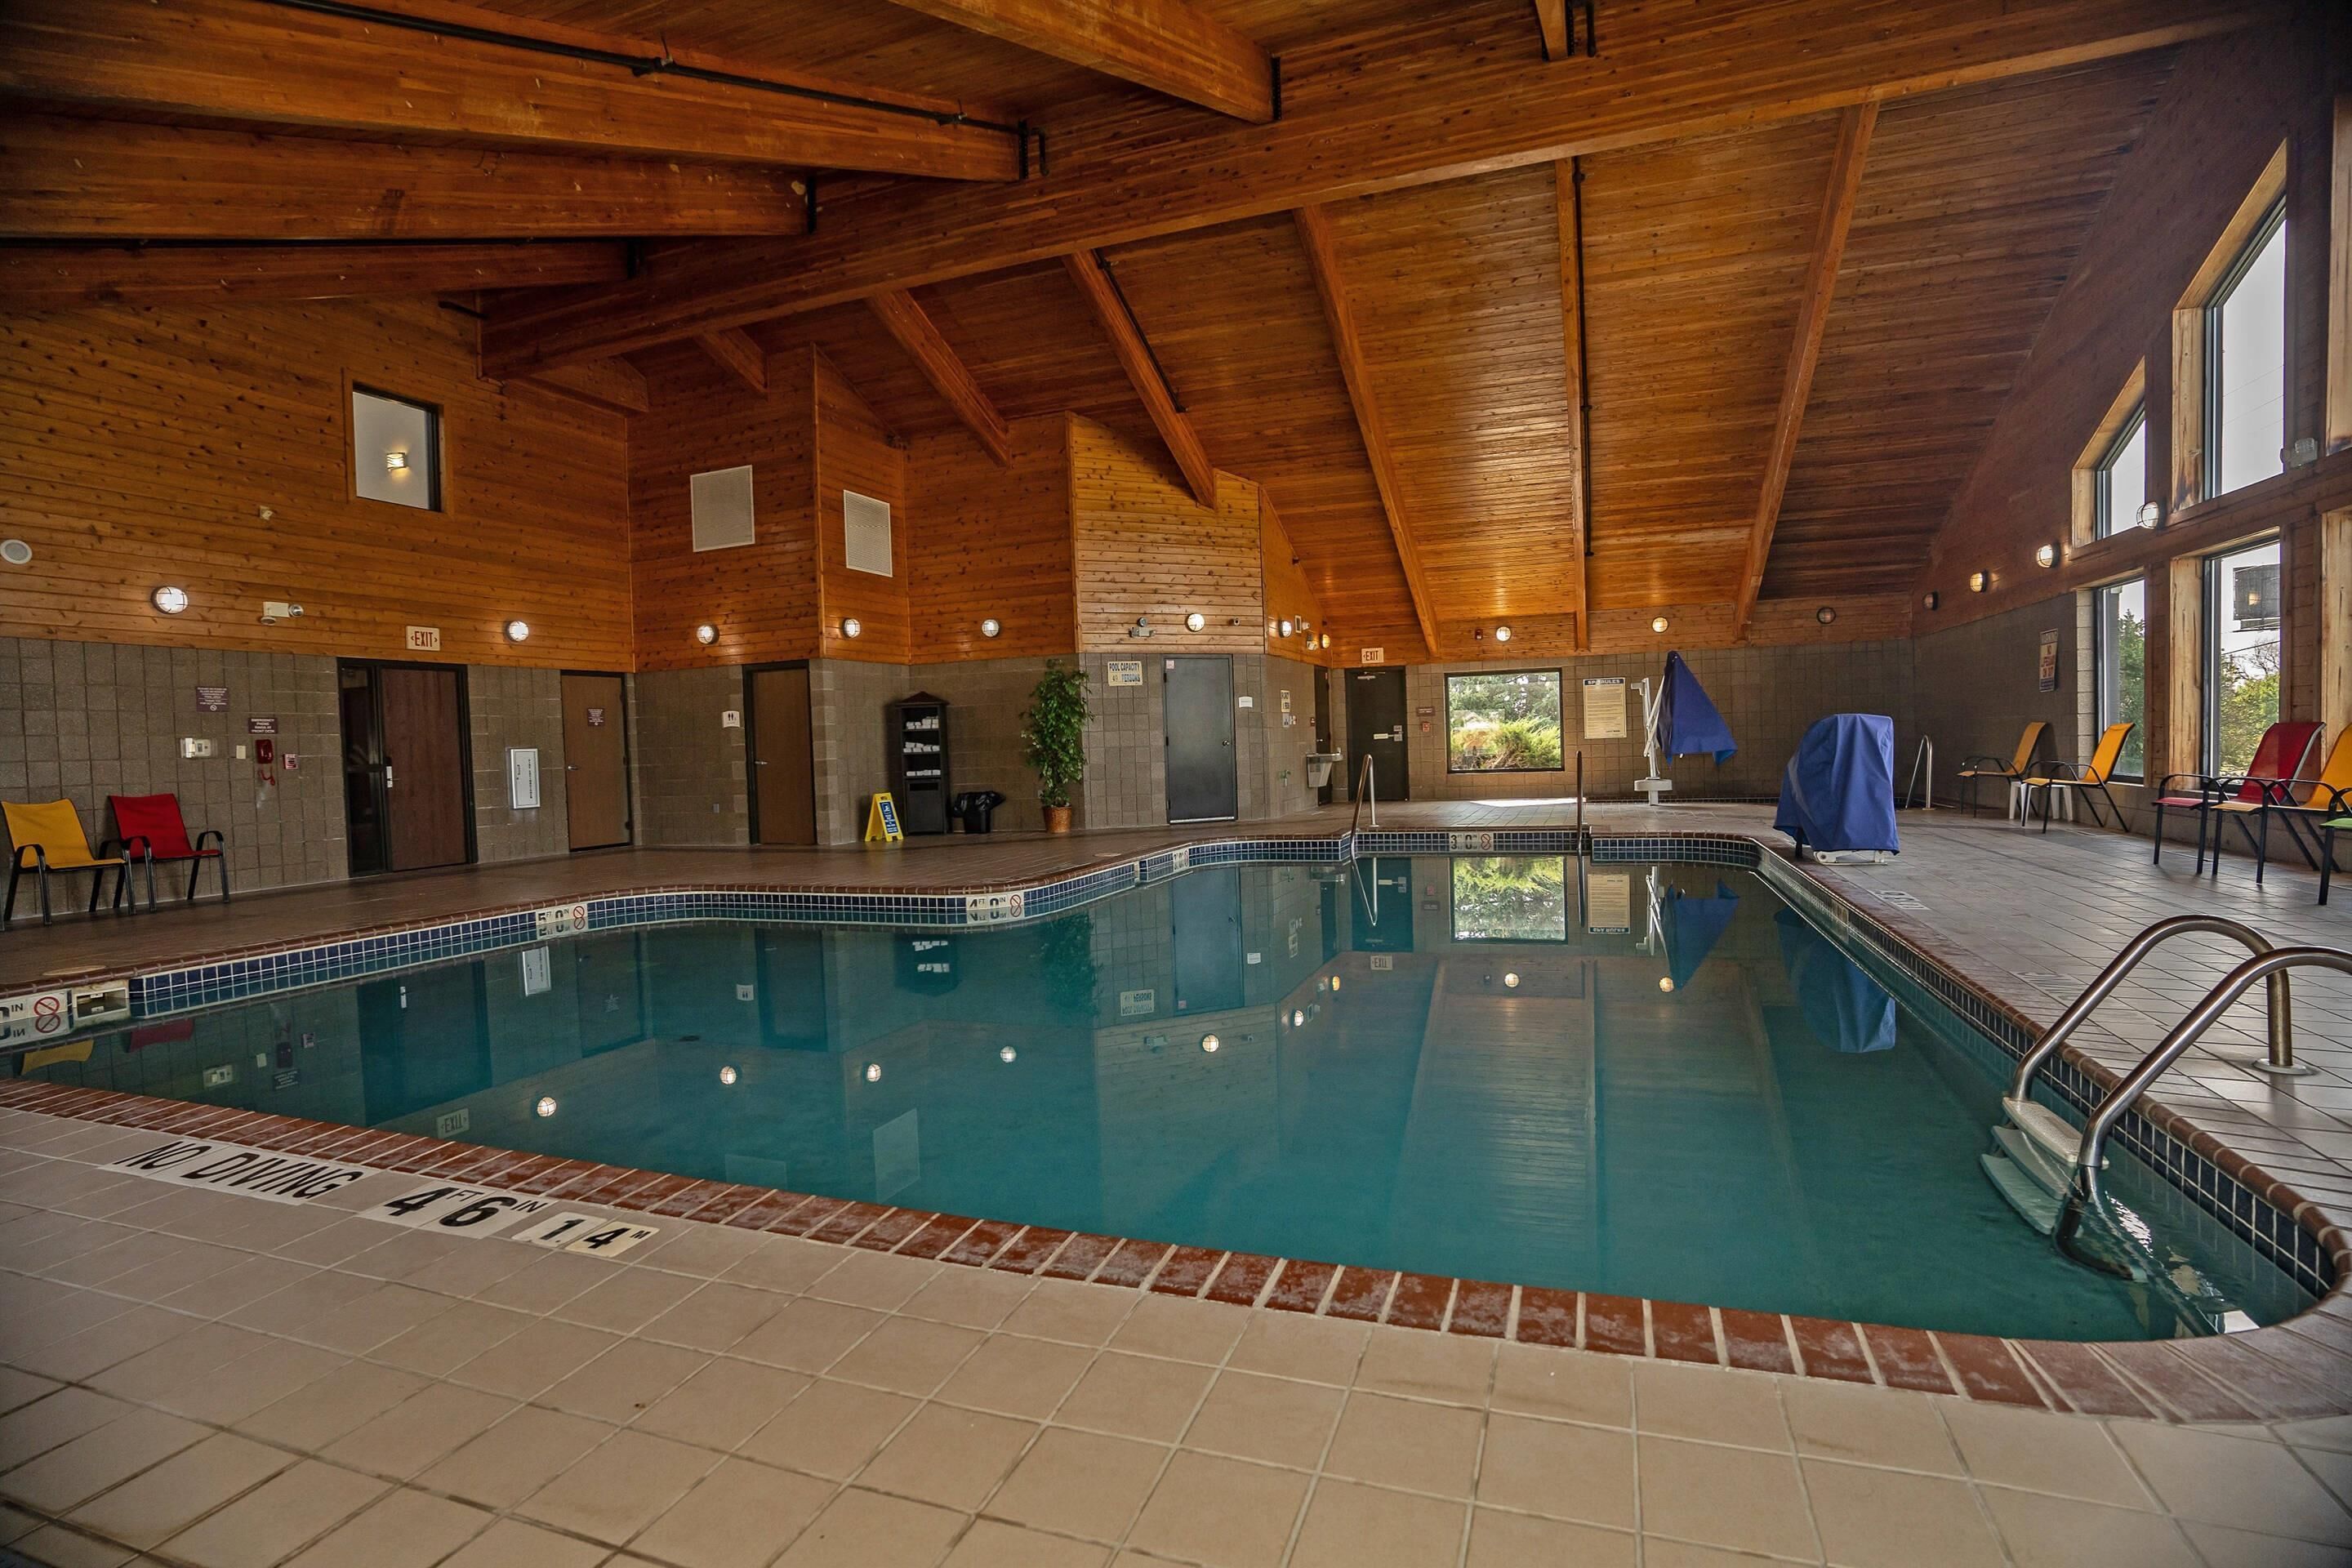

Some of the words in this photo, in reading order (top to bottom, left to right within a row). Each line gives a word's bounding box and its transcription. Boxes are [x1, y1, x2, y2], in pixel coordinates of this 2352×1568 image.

[415, 631, 433, 647] EXIT
[1365, 651, 1379, 661] EXIT
[1109, 662, 1120, 671] POOL
[1120, 662, 1139, 671] CAPACITY
[1121, 674, 1140, 682] PERSONS
[11, 1004, 23, 1012] IN
[112, 1141, 212, 1170] NO
[180, 1152, 363, 1199] DIVING
[446, 1189, 484, 1201] FT
[384, 1187, 460, 1217] 4
[510, 1200, 548, 1214] IN
[439, 1196, 518, 1227] 6
[629, 1230, 652, 1240] M
